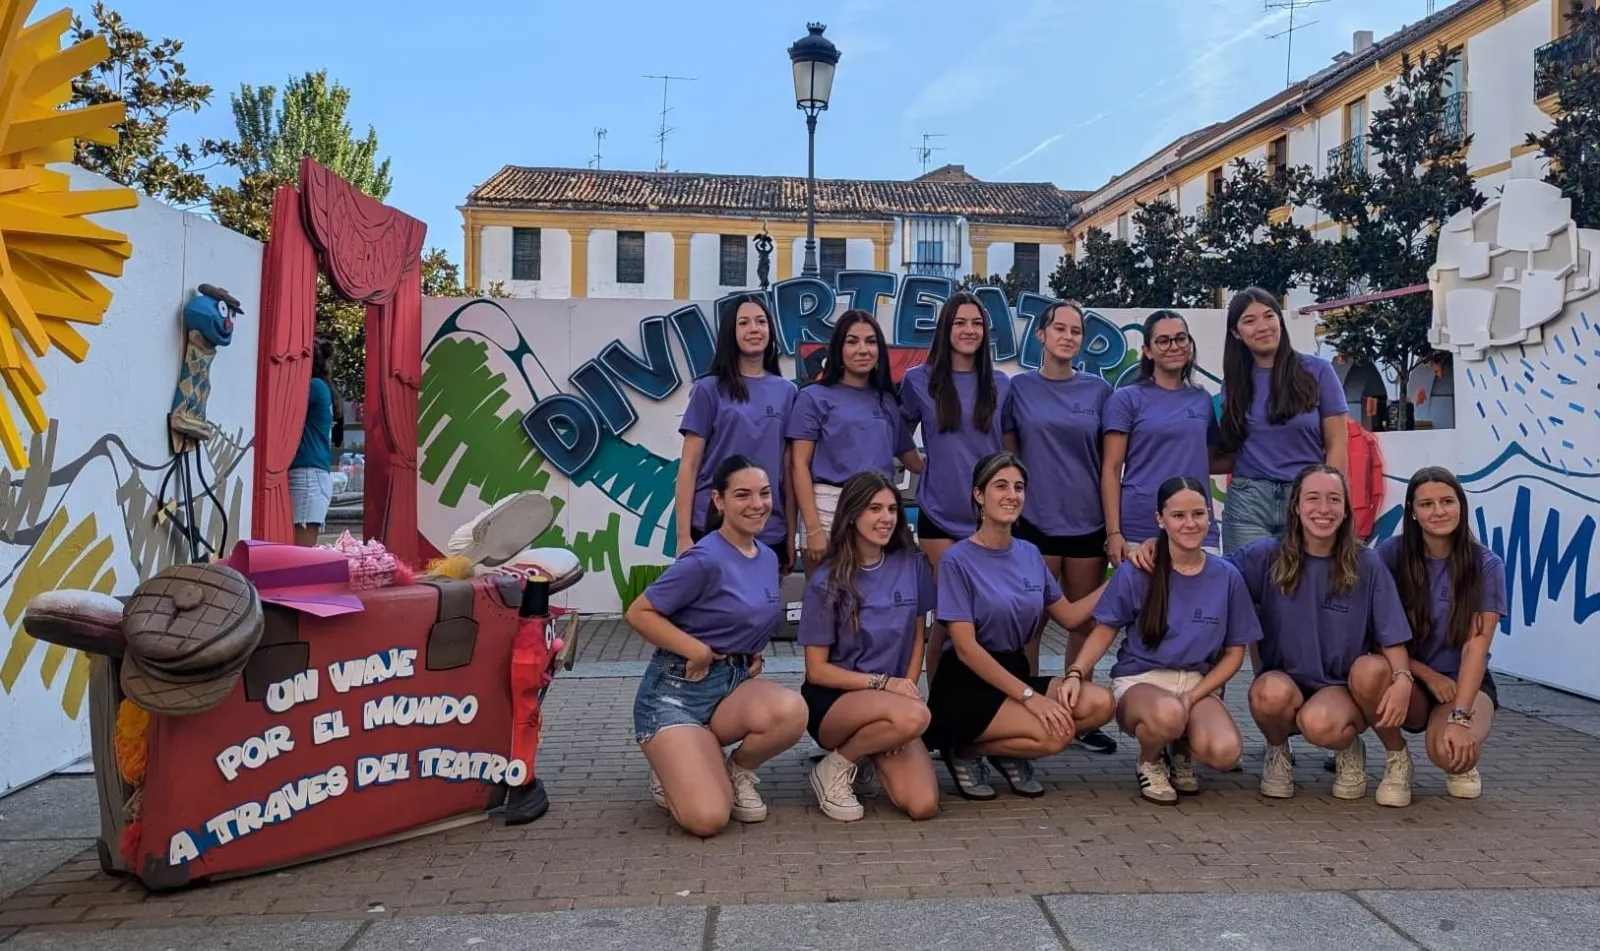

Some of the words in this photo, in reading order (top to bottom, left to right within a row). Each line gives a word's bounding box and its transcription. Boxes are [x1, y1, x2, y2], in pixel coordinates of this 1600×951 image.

[520, 269, 1148, 477] DIVIRTEATR
[266, 668, 319, 713] UN
[329, 648, 417, 692] VIAJE
[216, 725, 294, 781] POR
[313, 710, 349, 745] EL
[363, 695, 478, 730] MUNDO
[169, 830, 199, 866] A
[206, 766, 349, 845] TRAVES
[357, 753, 410, 787] DEL
[418, 748, 527, 787] TEATRO
